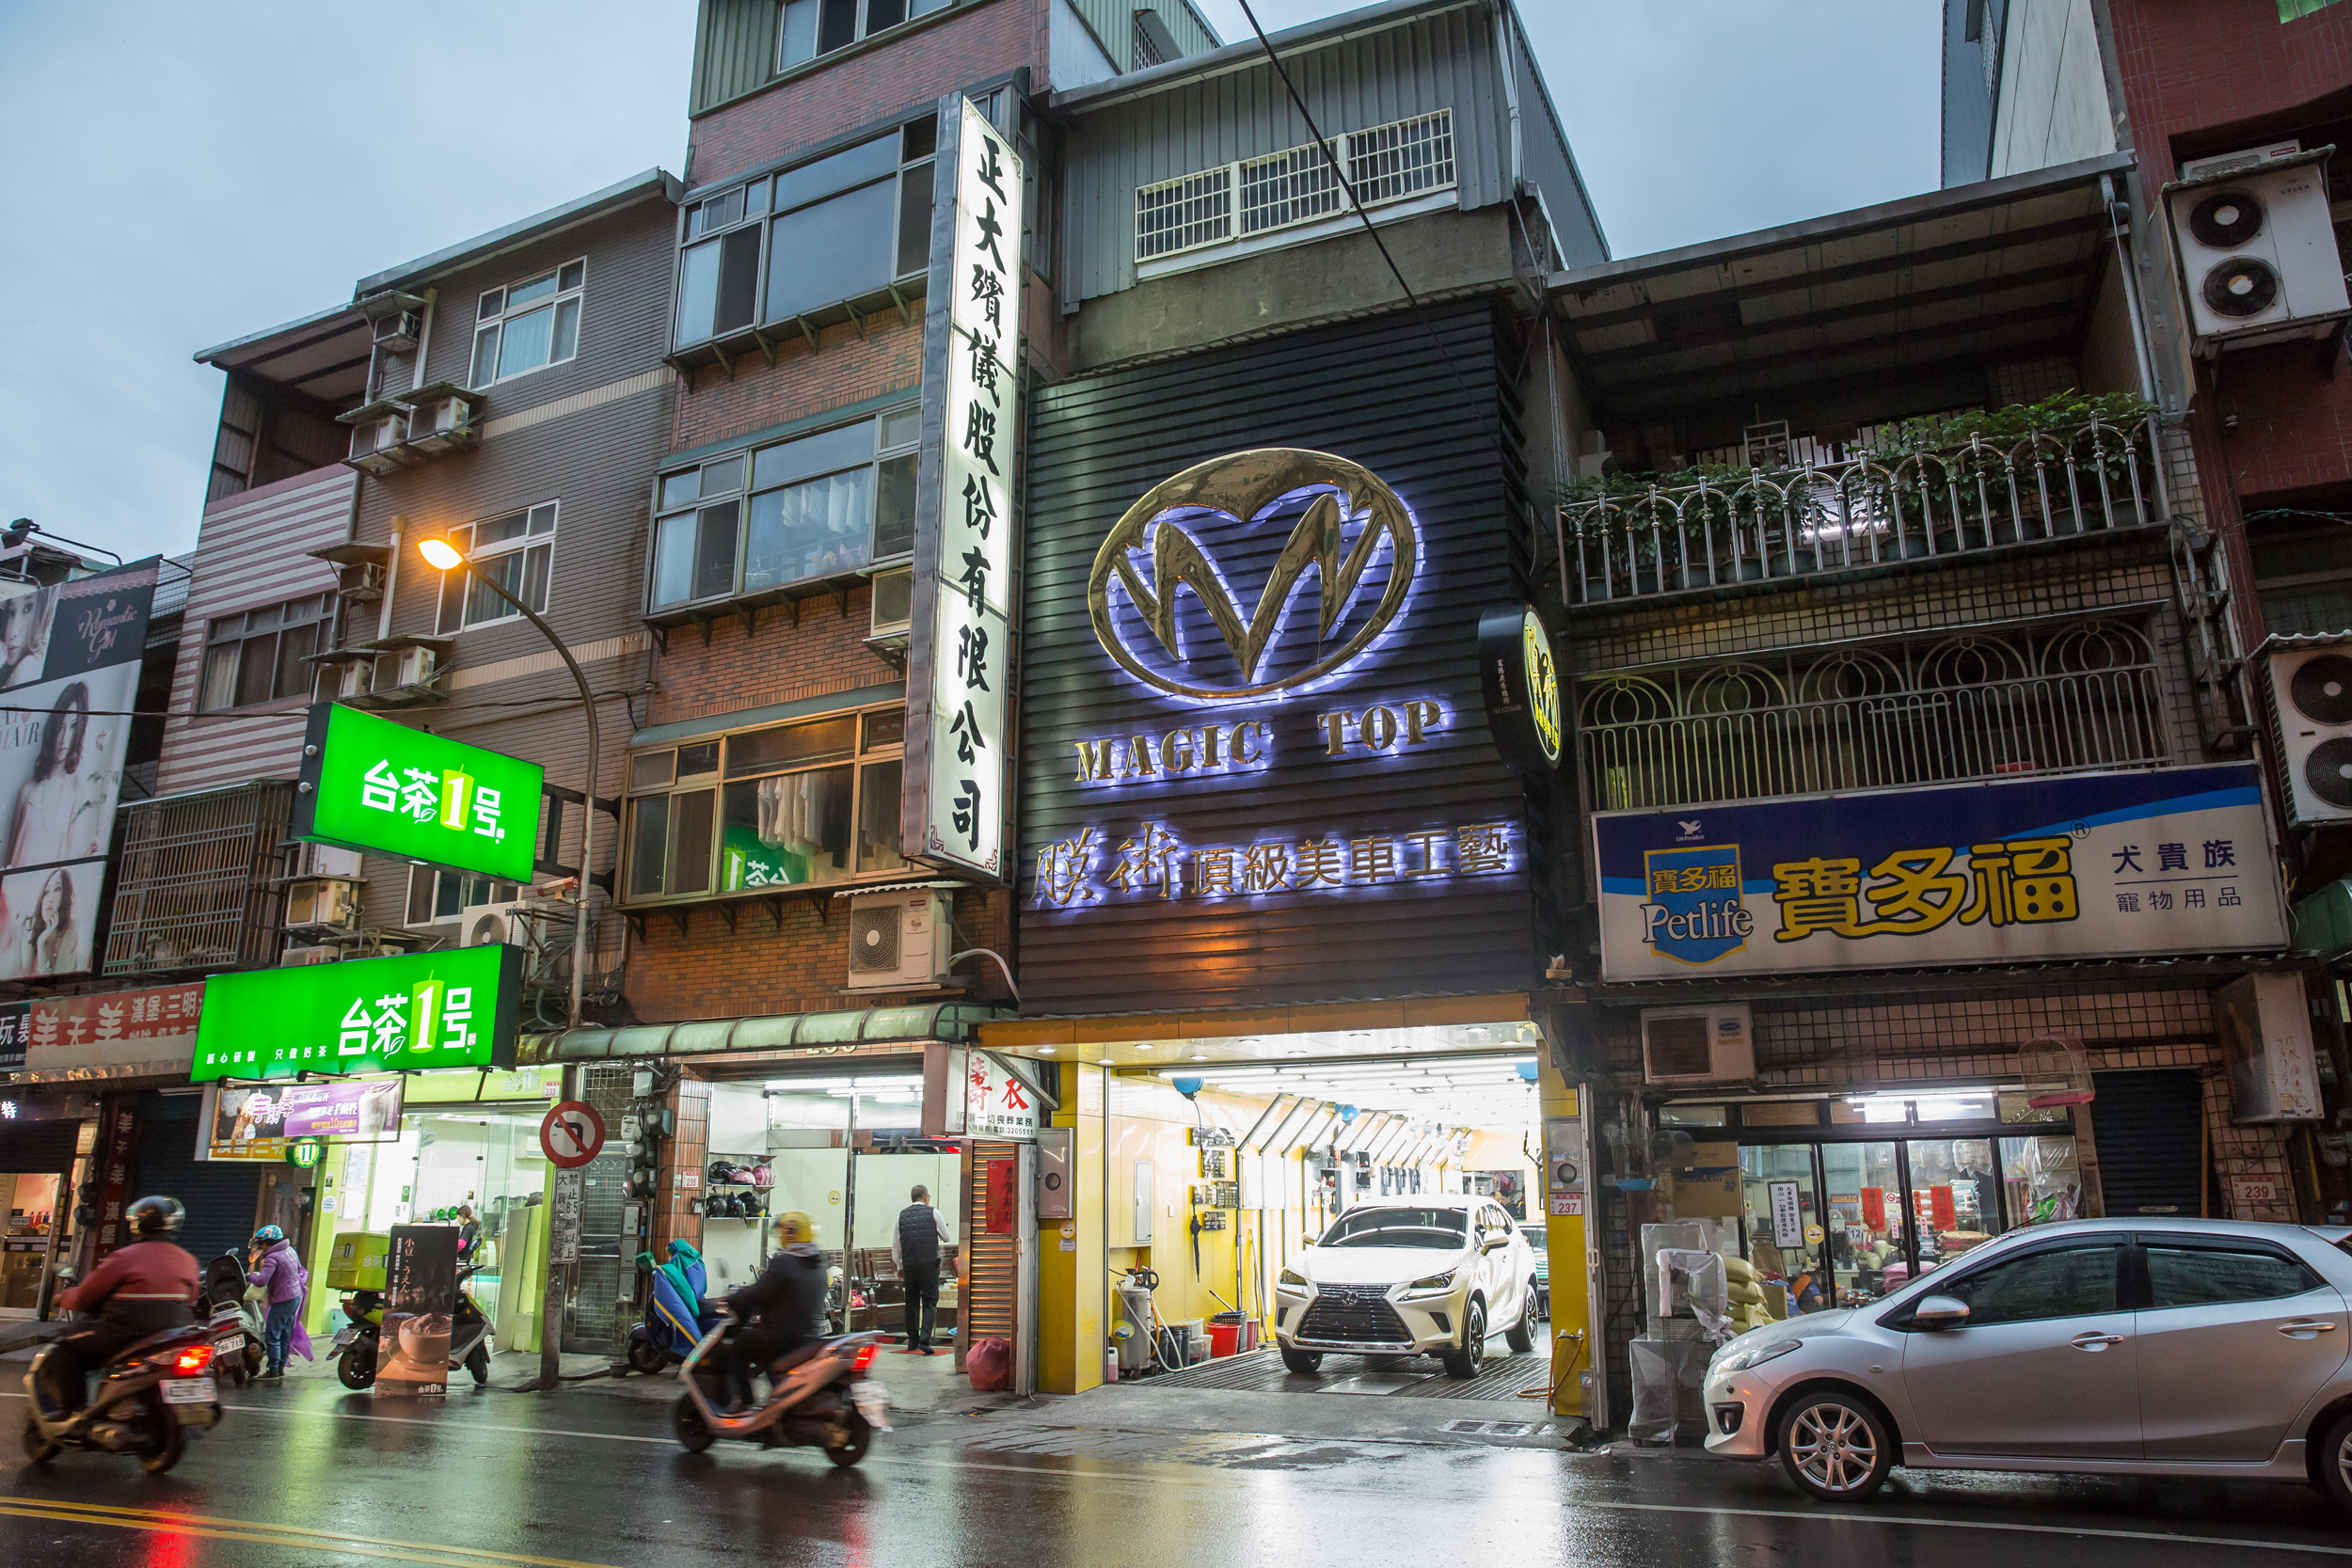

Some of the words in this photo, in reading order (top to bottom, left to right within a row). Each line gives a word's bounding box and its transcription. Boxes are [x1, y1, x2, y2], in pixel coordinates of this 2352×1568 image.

[78, 605, 137, 639] Romantic
[1073, 720, 1263, 784] MAGIC
[1317, 700, 1442, 756] TOP
[2110, 838, 2238, 875] 犬貴族
[1652, 863, 1738, 894] 寶多福
[1772, 834, 2080, 943] 寶多福
[2116, 886, 2243, 914] 寵物用品
[1639, 898, 1755, 943] Petlife
[338, 985, 473, 1056] 台茶1号
[206, 1050, 257, 1065] 誠心研製
[275, 1046, 327, 1061] 只做好茶
[686, 1178, 697, 1187] 235
[2245, 1185, 2269, 1198] 239
[1558, 1202, 1578, 1213] 237
[1850, 1229, 1861, 1238] 12
